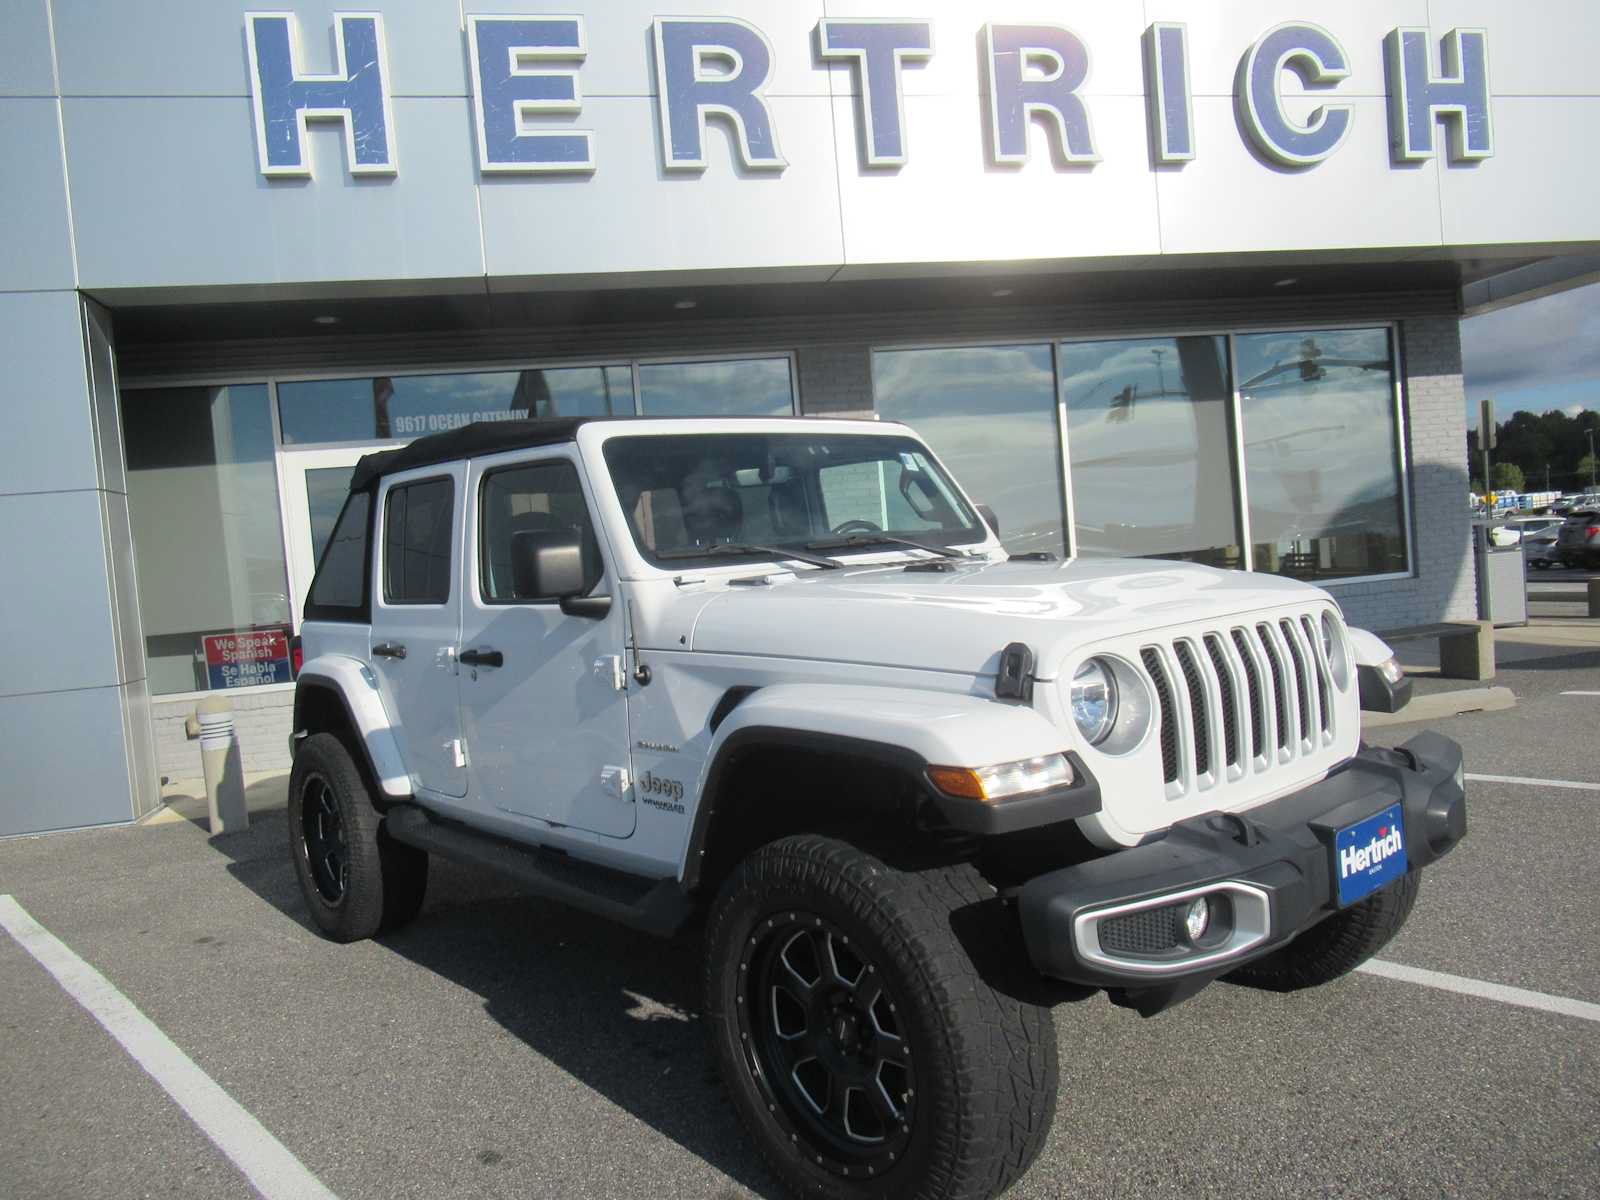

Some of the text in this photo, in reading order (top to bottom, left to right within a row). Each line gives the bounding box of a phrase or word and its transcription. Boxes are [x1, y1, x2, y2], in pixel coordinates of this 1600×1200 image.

[244, 11, 1494, 180] HERTRICH
[396, 409, 529, 433] 9617 OCEAN GATEWAY
[214, 635, 277, 651] We Speak
[223, 647, 272, 663] Spanish
[222, 662, 276, 676] Se Habla
[226, 674, 275, 687] Español
[1340, 825, 1402, 879] Hertrich
